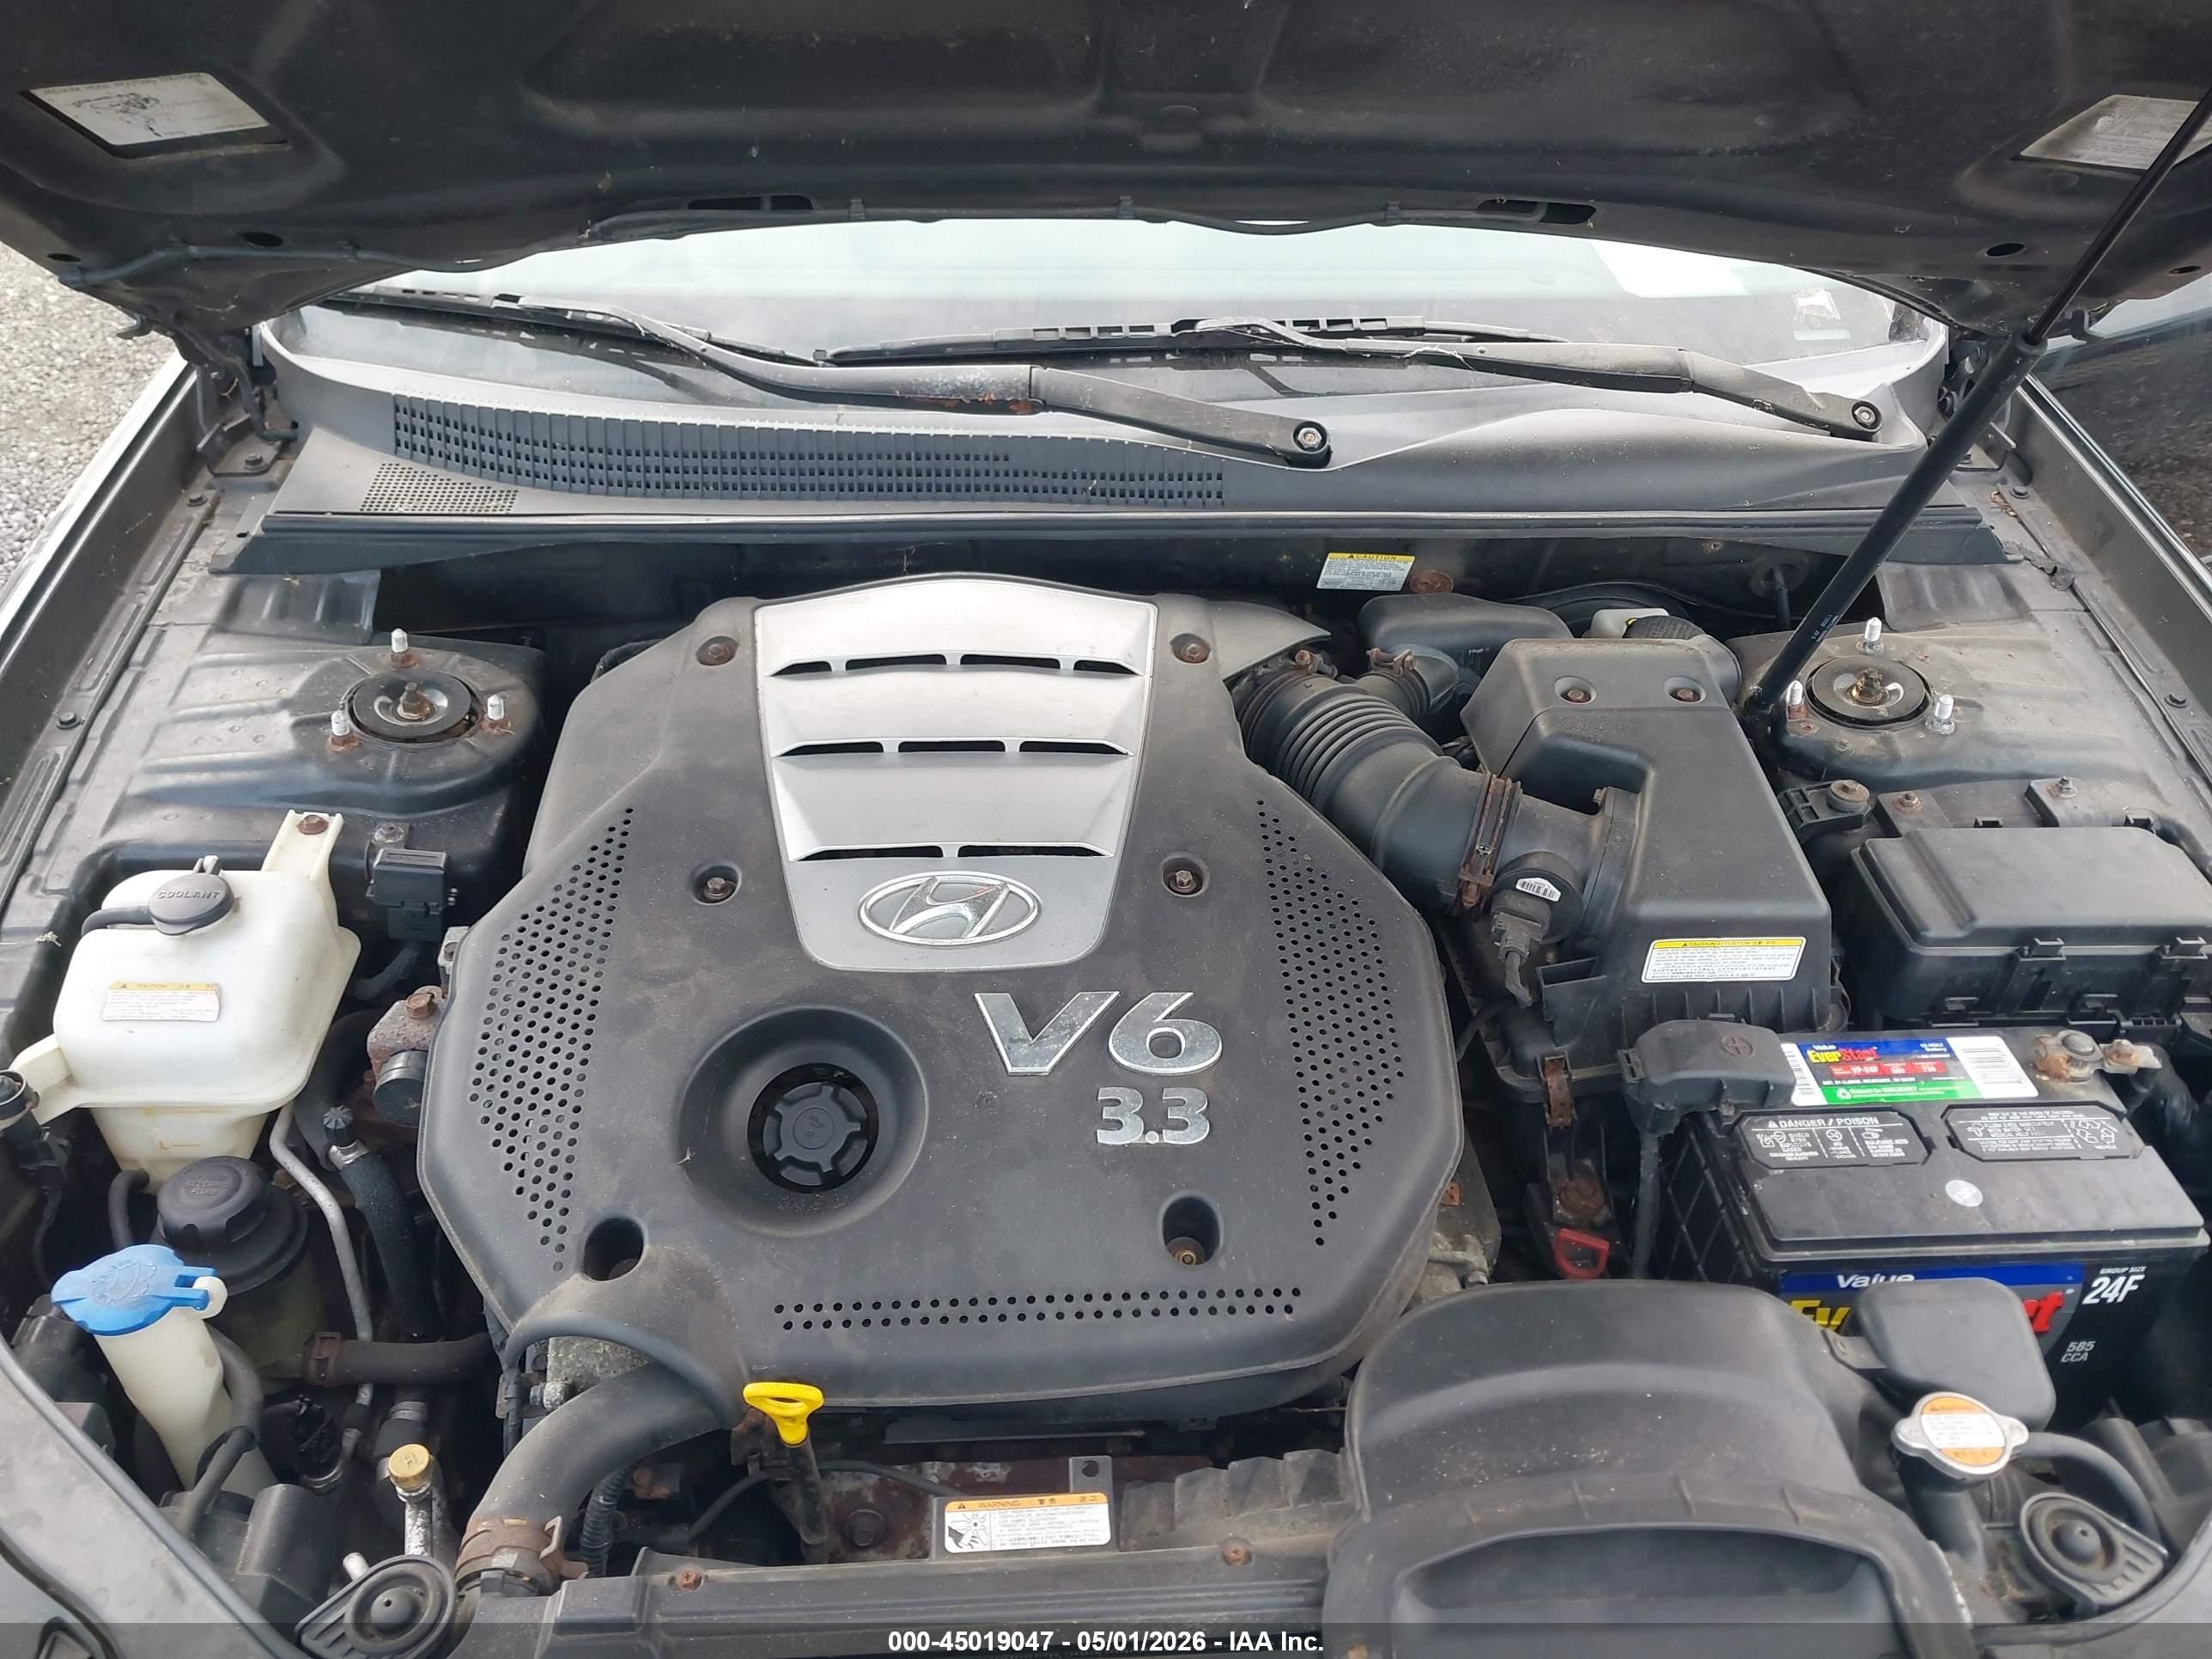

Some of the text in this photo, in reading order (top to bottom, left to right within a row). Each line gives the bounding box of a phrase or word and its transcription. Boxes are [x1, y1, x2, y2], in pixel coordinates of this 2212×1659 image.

[157, 890, 222, 900] COOLANT
[974, 991, 1223, 1075] V6
[1807, 1048, 1879, 1063] EverStart
[1097, 1086, 1211, 1146] 3.3
[1779, 1119, 1826, 1128] DANGER
[1836, 1117, 1880, 1126] POISON
[1837, 1273, 1915, 1289] Value
[2081, 1274, 2145, 1305] 24F
[2066, 1341, 2095, 1352] 585
[2061, 1352, 2088, 1363] CCA
